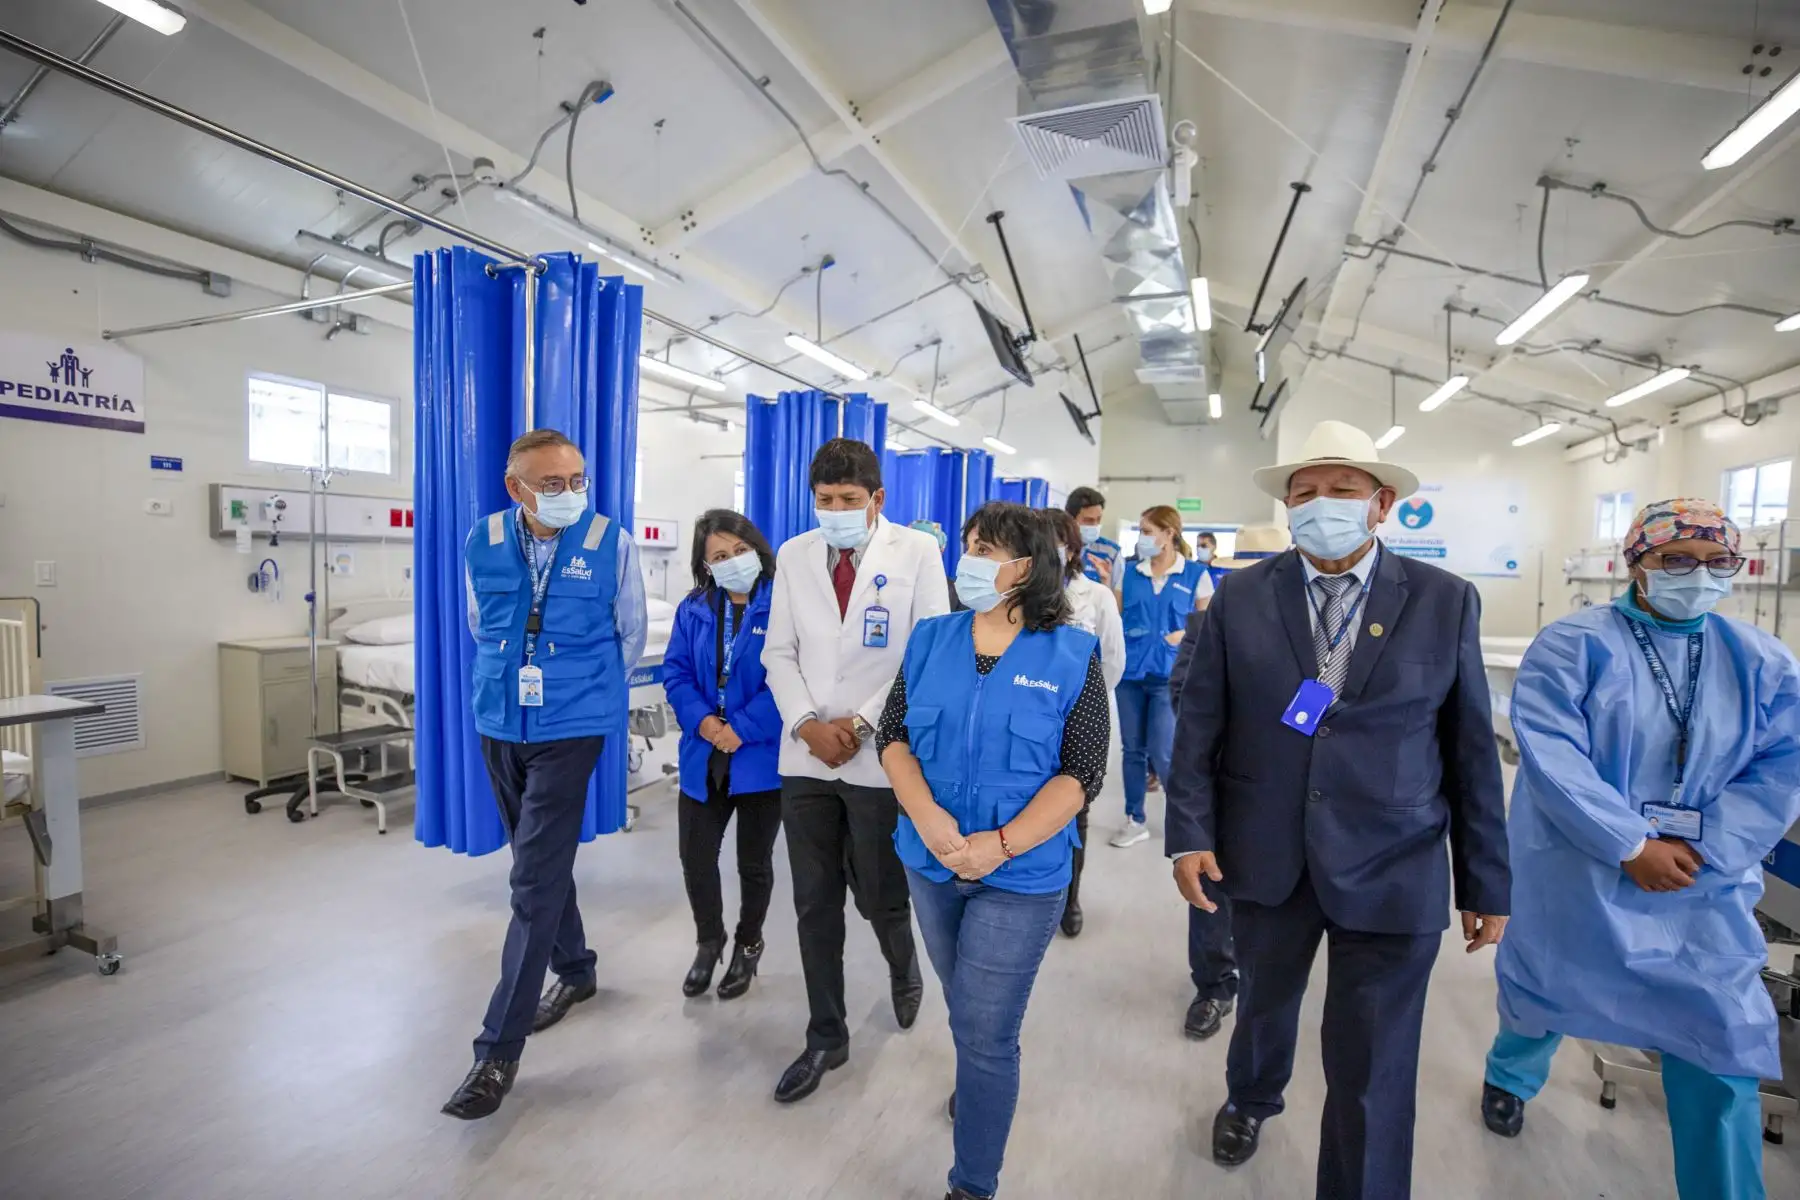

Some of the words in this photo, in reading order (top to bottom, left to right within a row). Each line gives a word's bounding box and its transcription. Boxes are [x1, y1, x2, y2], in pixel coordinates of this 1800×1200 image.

[0, 381, 136, 413] PEDIATRÍA
[561, 566, 593, 577] EsSalud
[1029, 679, 1059, 693] EsSalud
